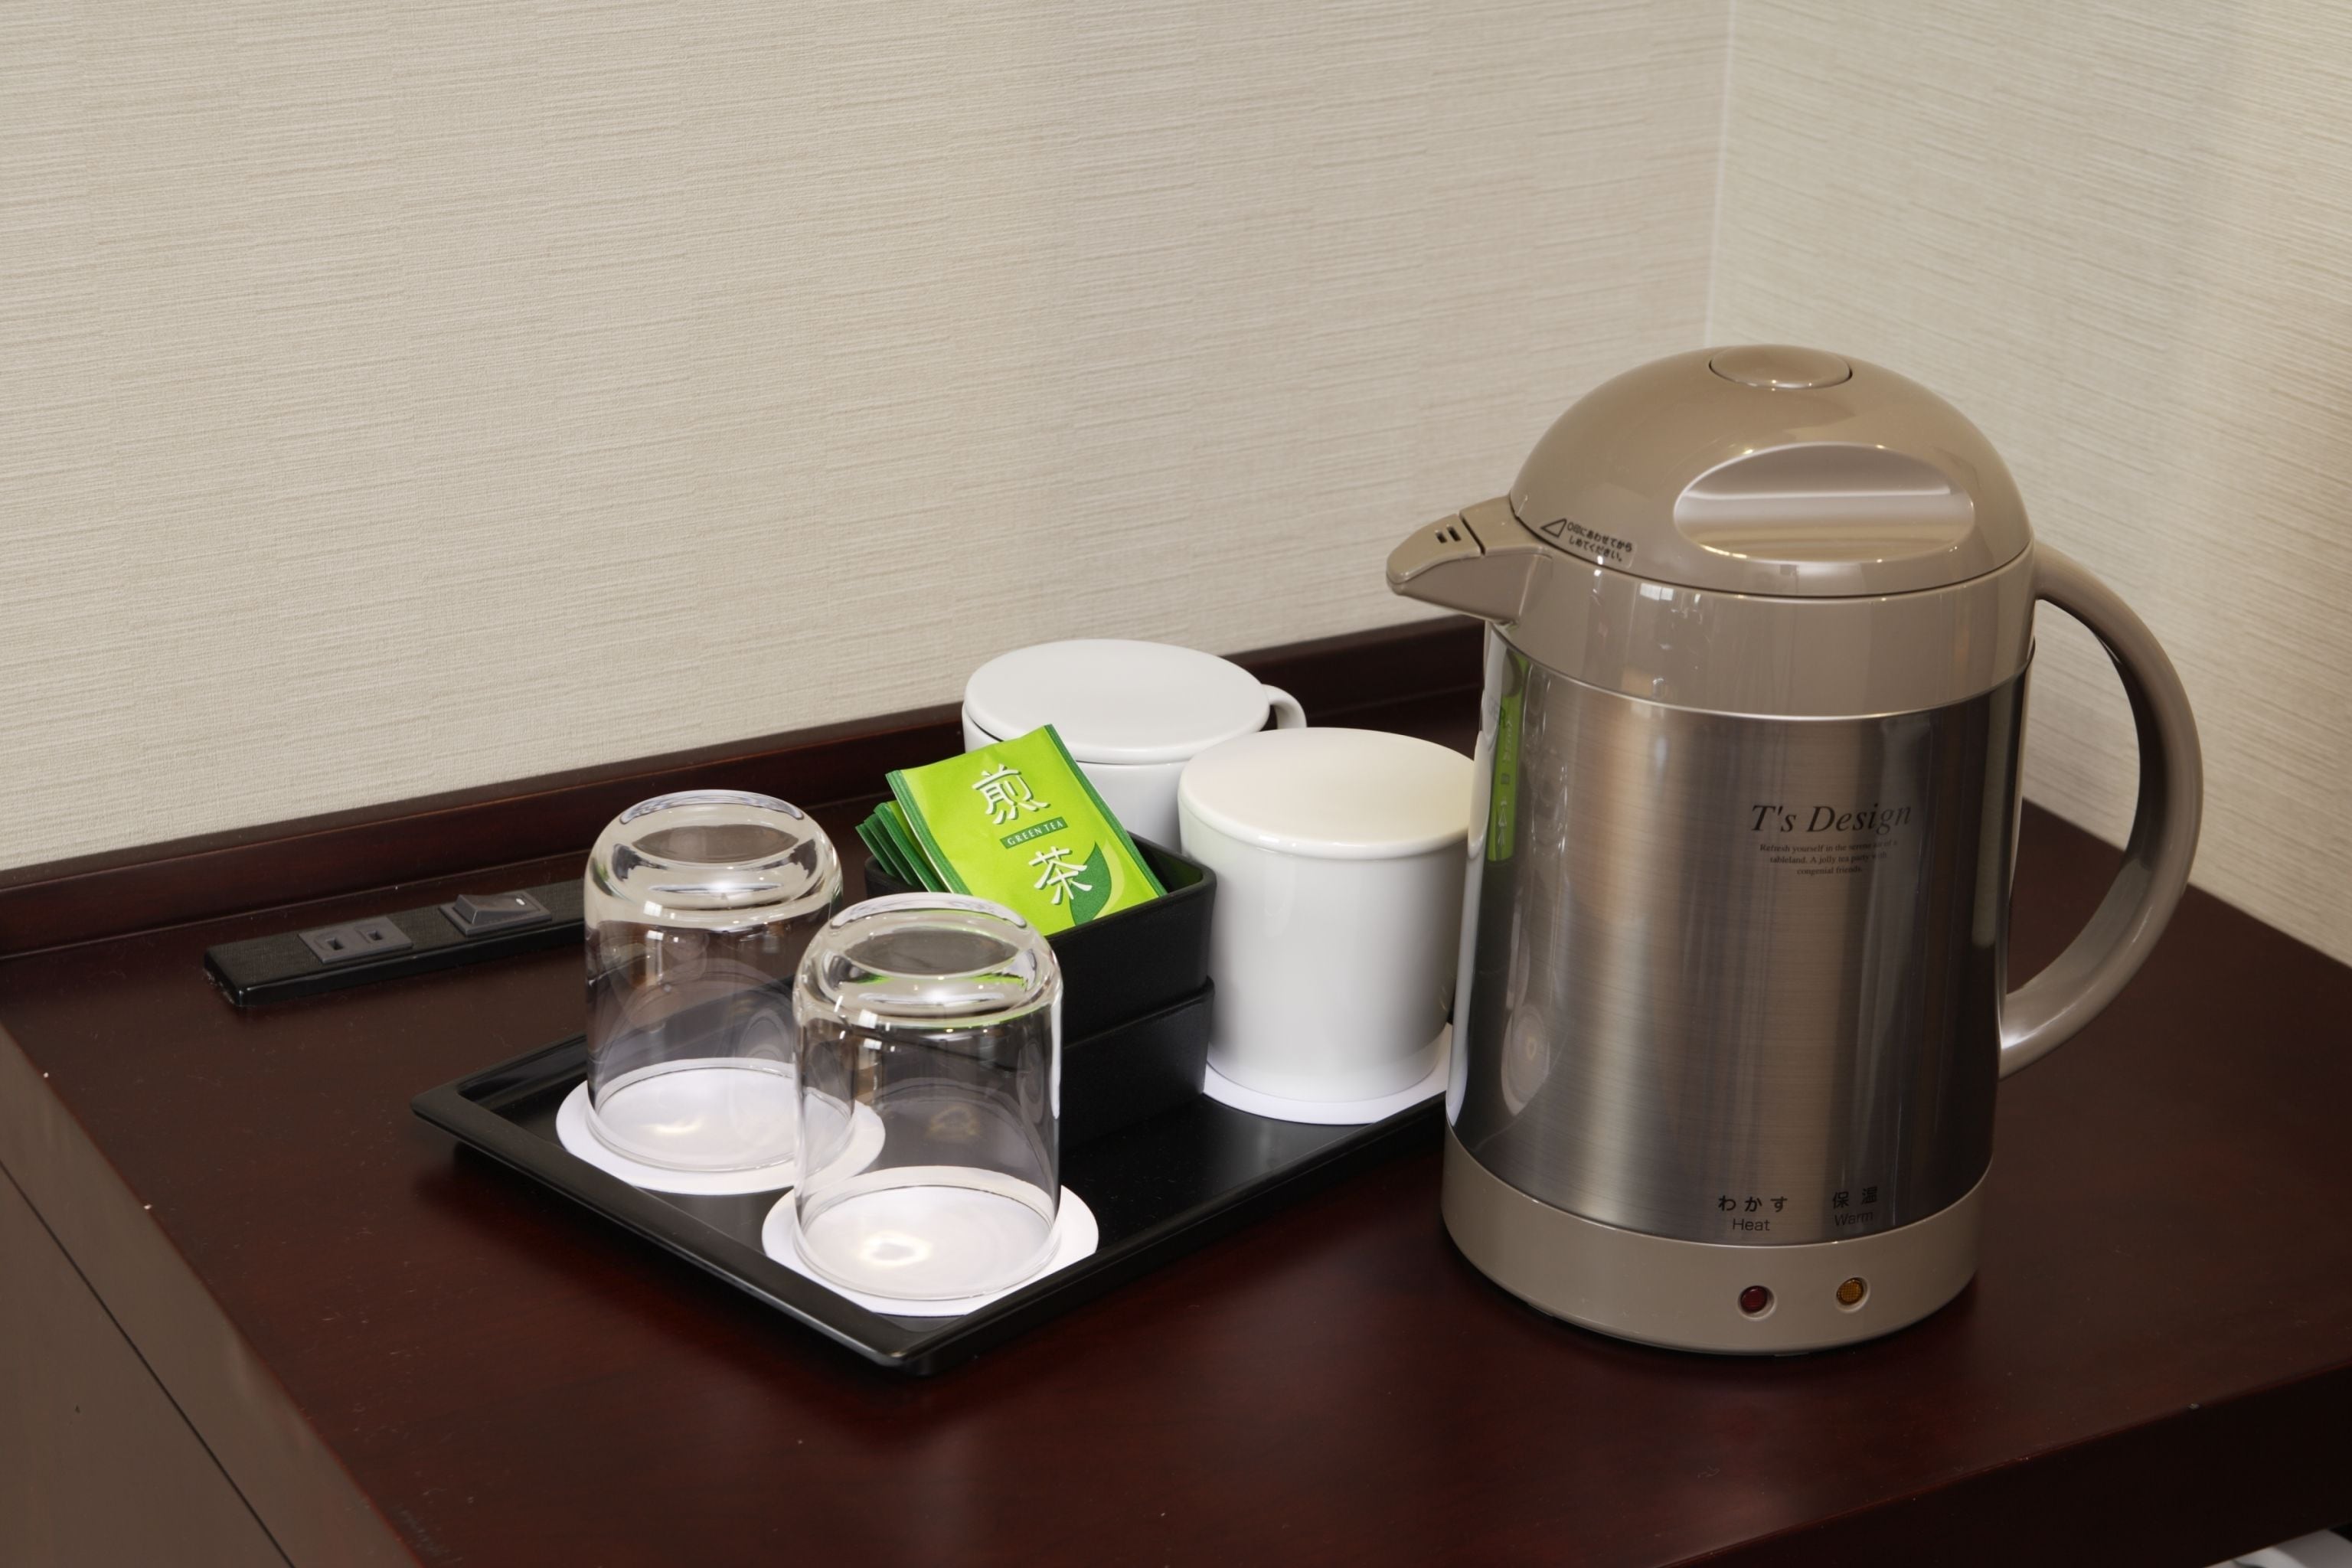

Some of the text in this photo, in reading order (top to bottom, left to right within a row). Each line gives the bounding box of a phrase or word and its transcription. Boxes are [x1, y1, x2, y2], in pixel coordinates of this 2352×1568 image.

[972, 763, 1051, 825] 煎
[1751, 802, 1912, 835] T's Design
[1006, 819, 1064, 846] GREEN TEA
[1759, 844, 1791, 852] Refresh
[1792, 844, 1824, 854] yourself
[1769, 855, 1808, 864] tableland.
[1810, 855, 1817, 864] A
[1818, 855, 1836, 865] jolly
[1851, 854, 1869, 864] party
[1028, 846, 1093, 904] 茶
[1796, 867, 1834, 877] congenial
[1717, 1195, 1788, 1213] わかす
[1832, 1186, 1878, 1210] 保温
[1733, 1218, 1770, 1231] Heat
[1834, 1211, 1873, 1227] Warm
